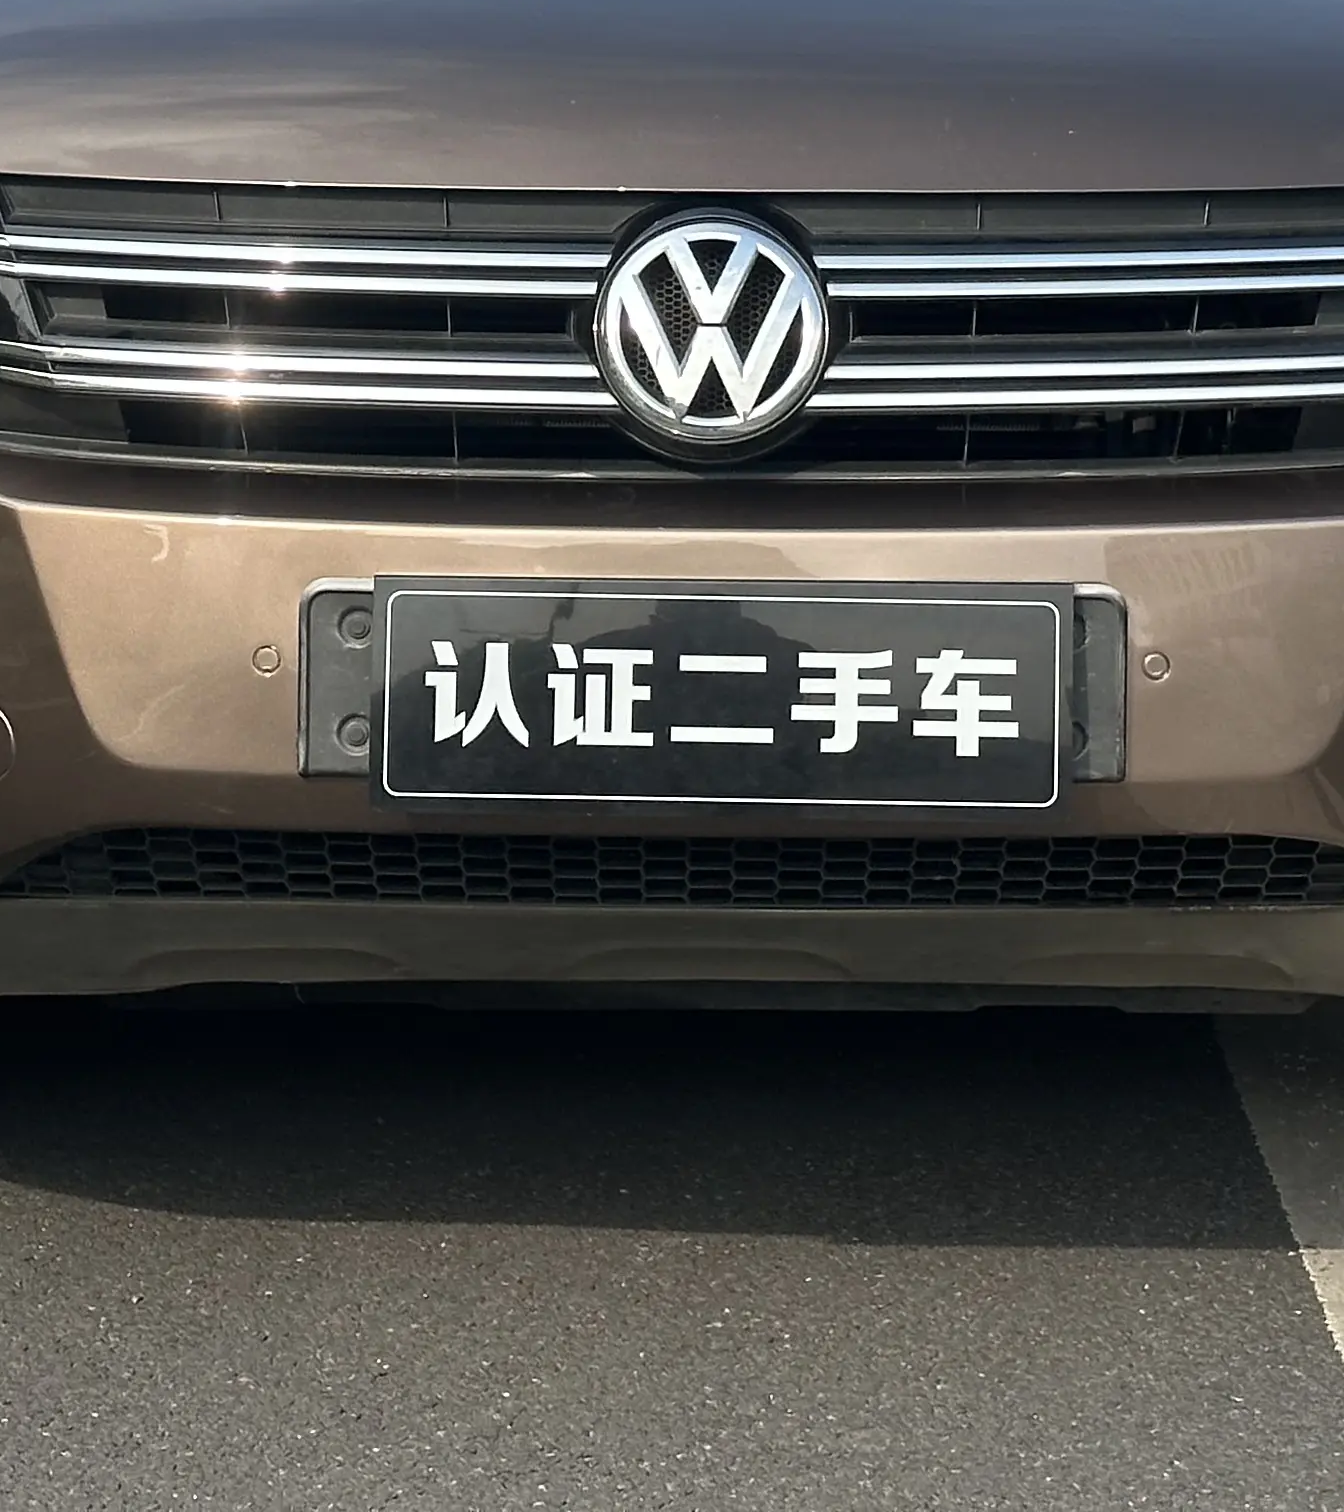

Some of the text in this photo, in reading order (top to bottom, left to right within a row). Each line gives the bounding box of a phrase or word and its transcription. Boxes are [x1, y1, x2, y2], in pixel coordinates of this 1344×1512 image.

[613, 226, 813, 426] VW
[425, 640, 1020, 759] 认证二手车
